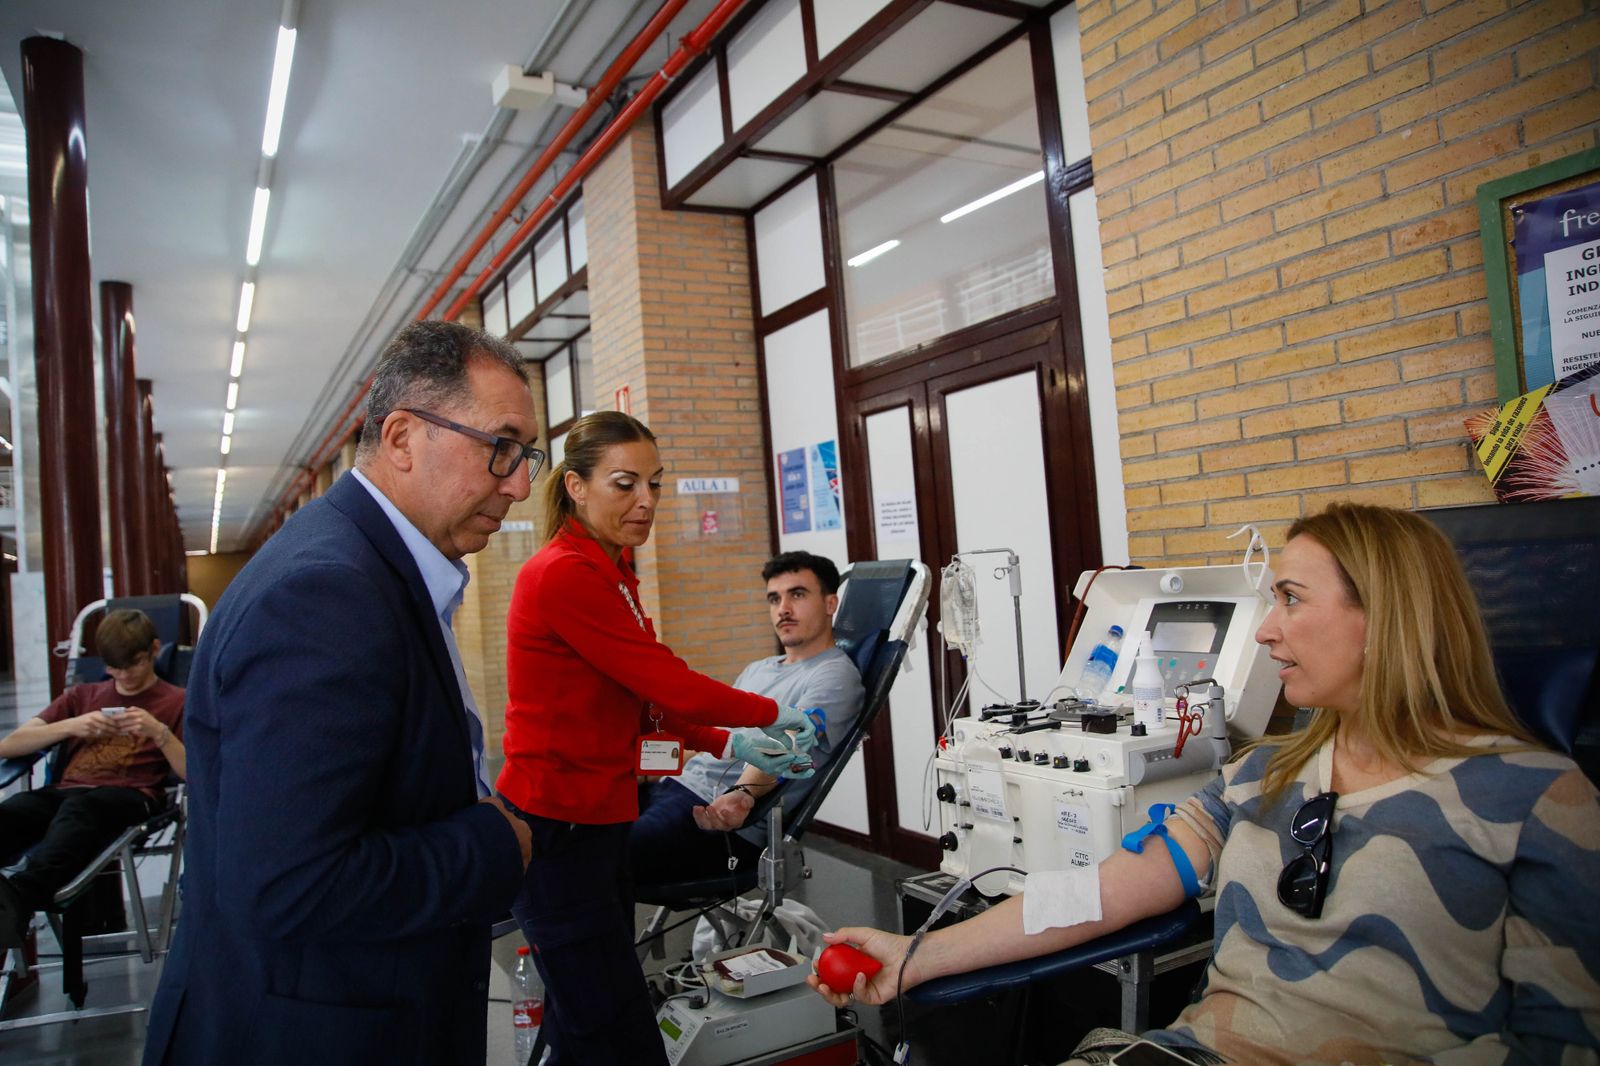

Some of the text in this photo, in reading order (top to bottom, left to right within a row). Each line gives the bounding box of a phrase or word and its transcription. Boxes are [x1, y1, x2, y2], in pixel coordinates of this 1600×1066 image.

[1566, 264, 1600, 282] ING
[1505, 437, 1515, 451] para
[683, 479, 728, 491] AULA 1
